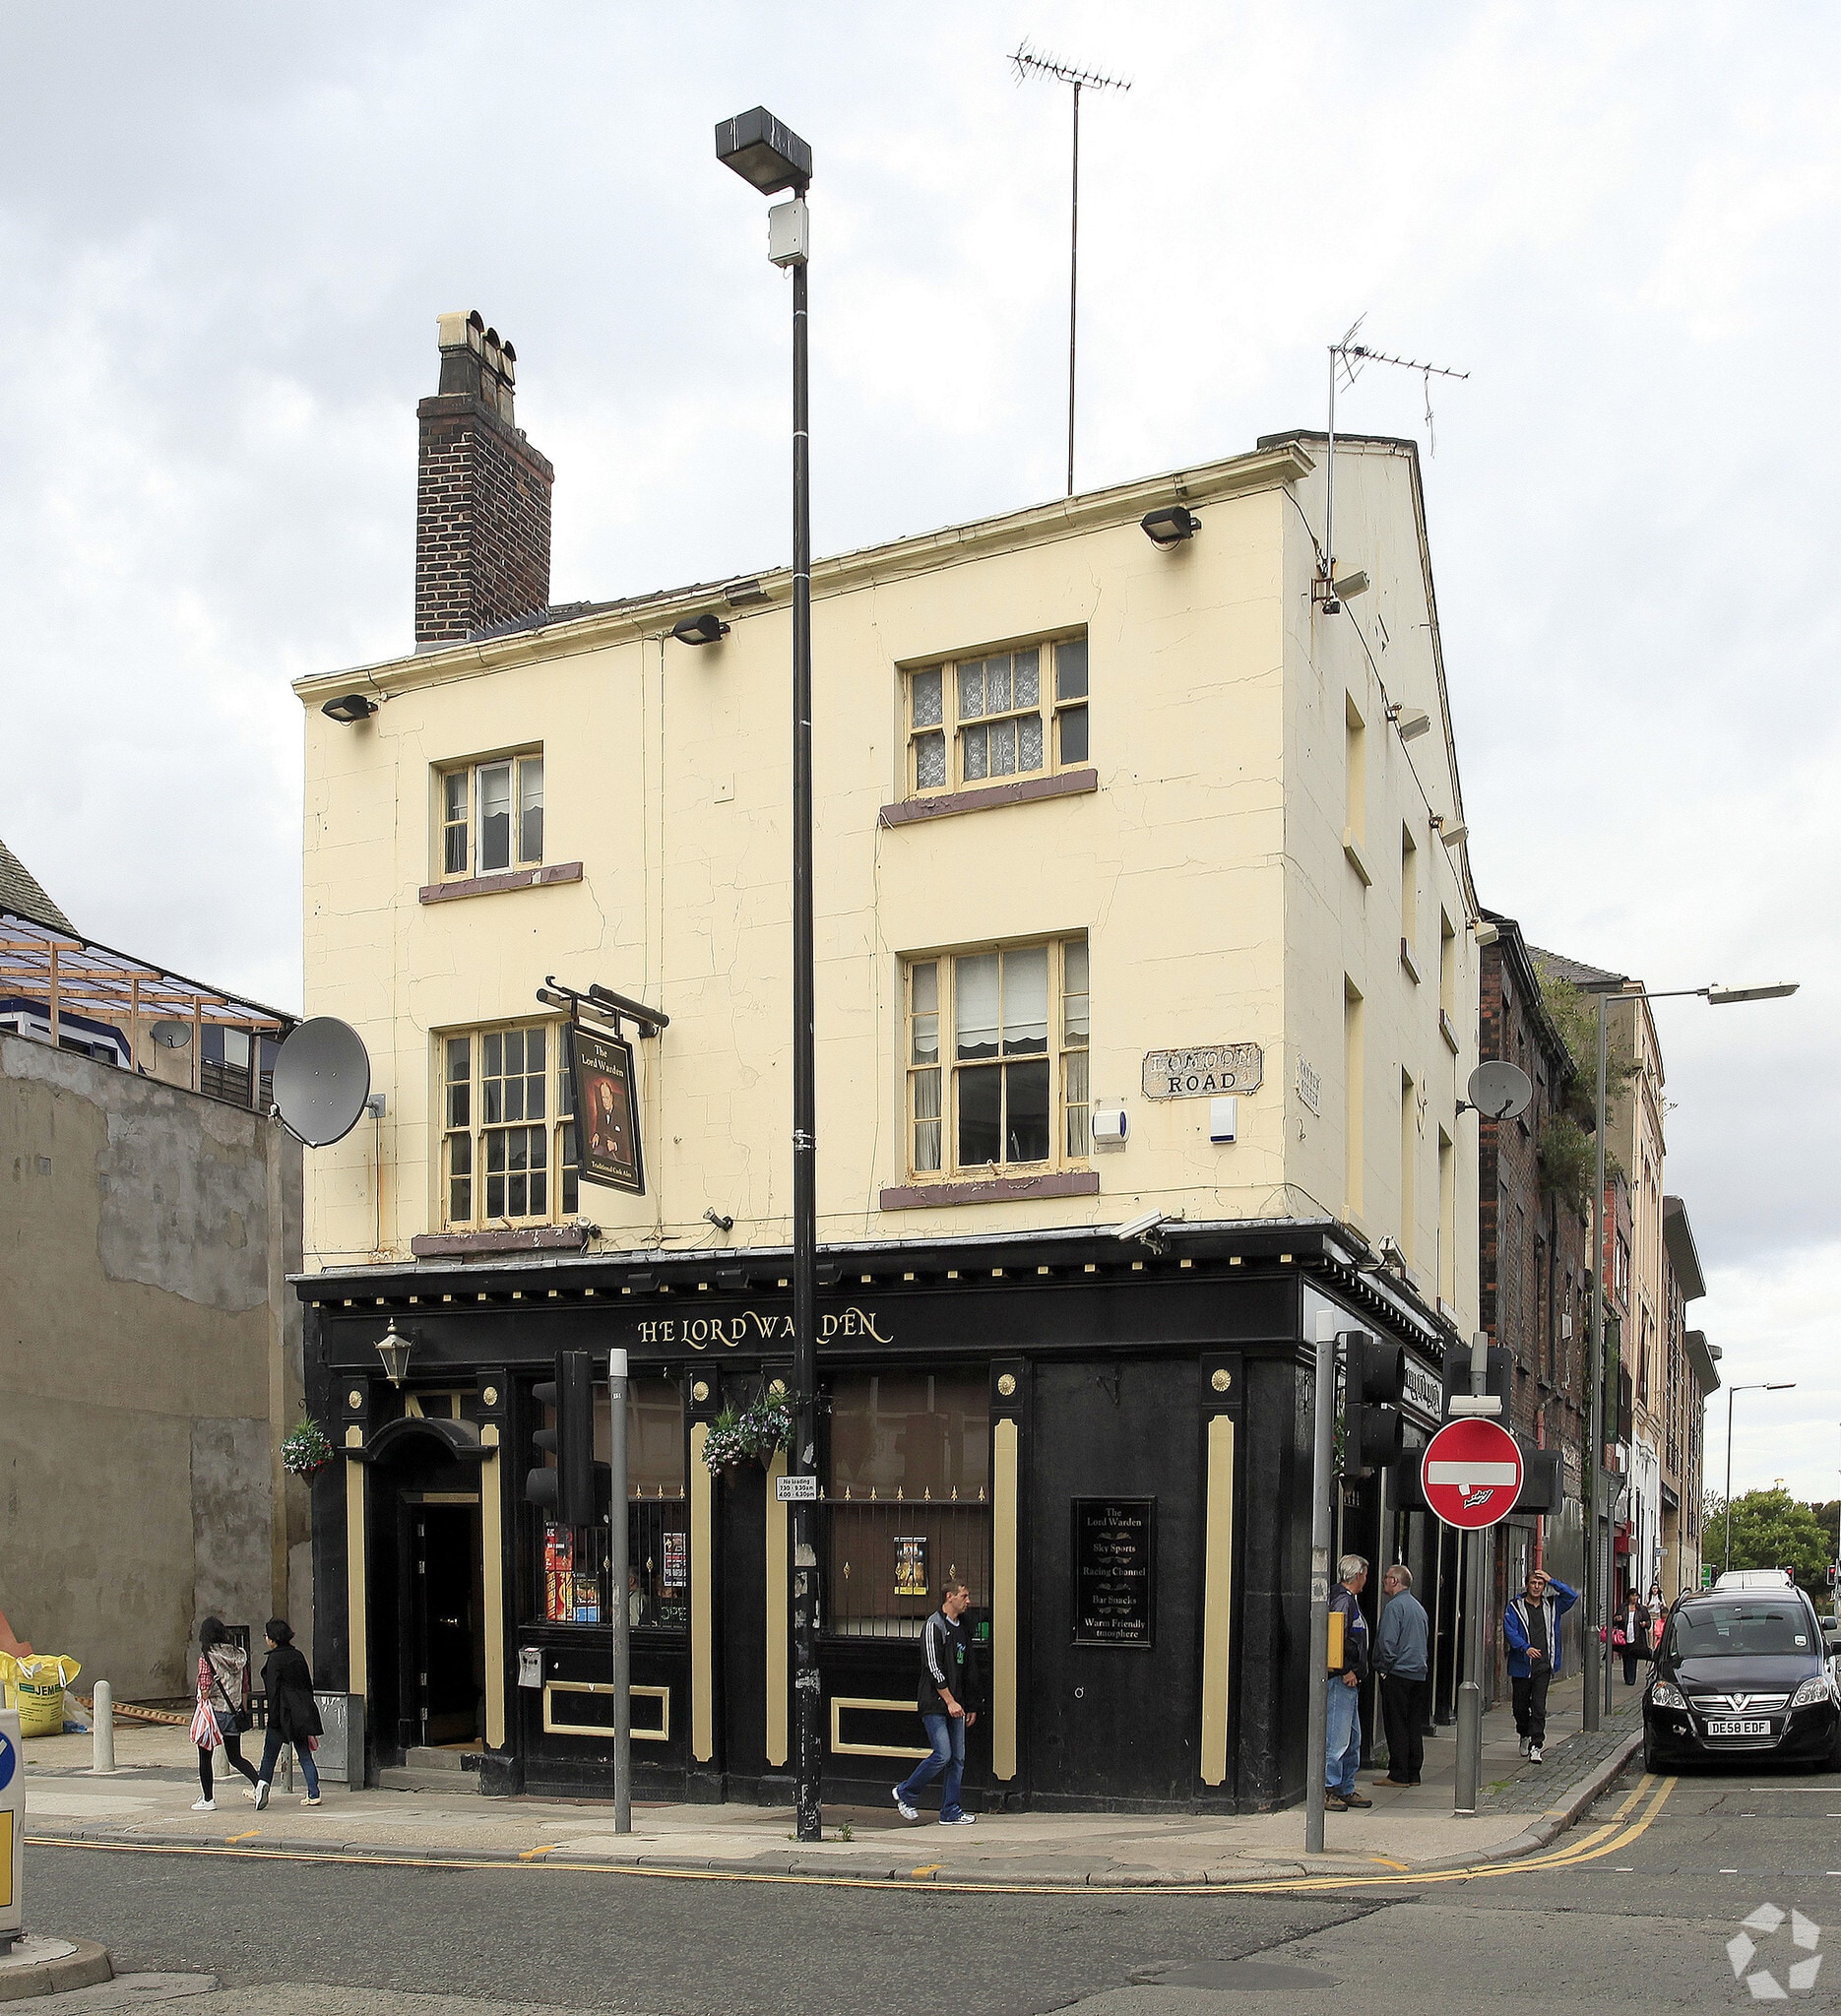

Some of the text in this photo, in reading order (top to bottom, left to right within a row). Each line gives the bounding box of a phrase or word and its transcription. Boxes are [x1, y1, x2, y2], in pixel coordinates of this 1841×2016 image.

[594, 1044, 607, 1058] The
[581, 1053, 624, 1078] Lord Warden
[1168, 1073, 1237, 1093] ROAD
[681, 1318, 746, 1350] LORD
[741, 1306, 894, 1345] WADEN
[1105, 1507, 1122, 1517] The
[1087, 1517, 1142, 1526] Lord Warden
[1093, 1544, 1136, 1554] Sky Sports
[1083, 1566, 1146, 1577] Racing Channel
[1093, 1595, 1137, 1605] Bar Snacks
[1084, 1617, 1146, 1629] Warm Friendly
[1712, 1723, 1766, 1733] DE58 EDF
